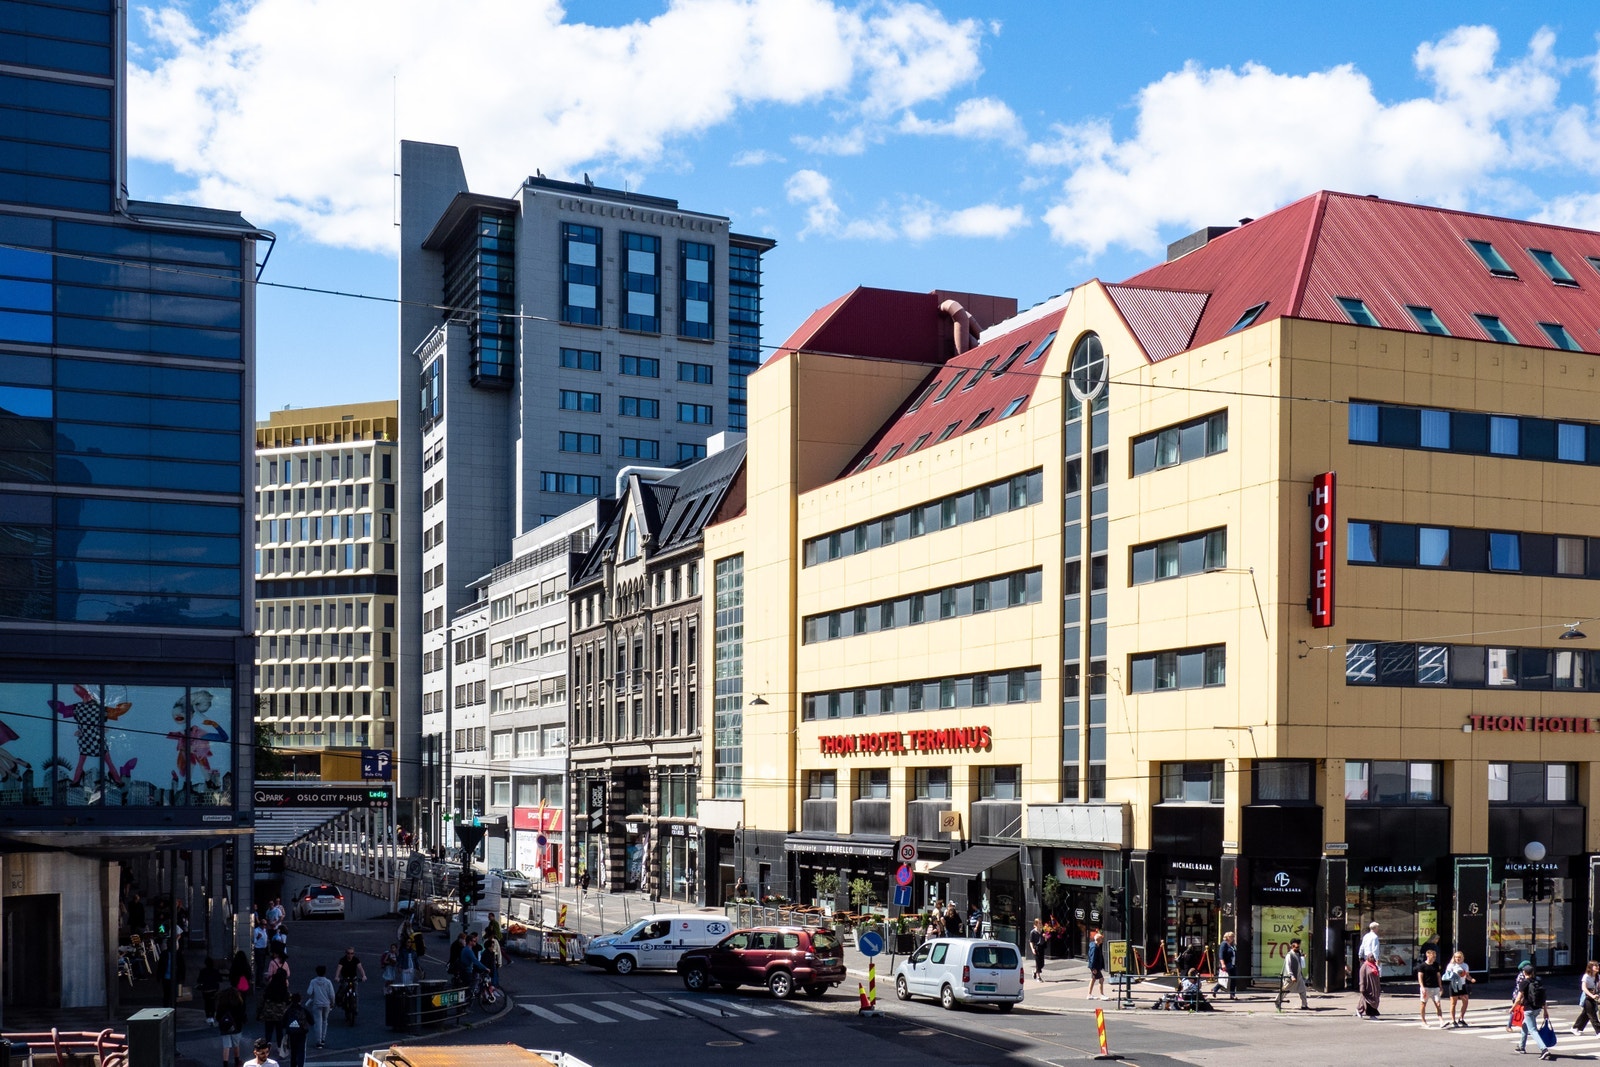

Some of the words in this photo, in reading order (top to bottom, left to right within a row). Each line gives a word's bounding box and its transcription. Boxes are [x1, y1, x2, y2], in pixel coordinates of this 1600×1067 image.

[1315, 485, 1329, 616] HOTEL
[1469, 714, 1527, 732] THON
[1534, 716, 1596, 734] HOTEL
[817, 734, 856, 754] THON
[859, 731, 905, 753] HOTEL
[907, 725, 990, 751] TERMINUS
[297, 794, 319, 802] OSLO
[320, 794, 338, 802] CITY
[339, 794, 363, 802] P-HUS
[369, 791, 387, 799] Ledig
[793, 844, 817, 852] Ristorante
[825, 845, 853, 854] BRUNELLO
[903, 848, 913, 857] 30
[1060, 856, 1080, 867] THON
[1081, 858, 1104, 869] HOTEL
[1065, 868, 1100, 880] TERMINUS
[1273, 924, 1294, 933] DAY
